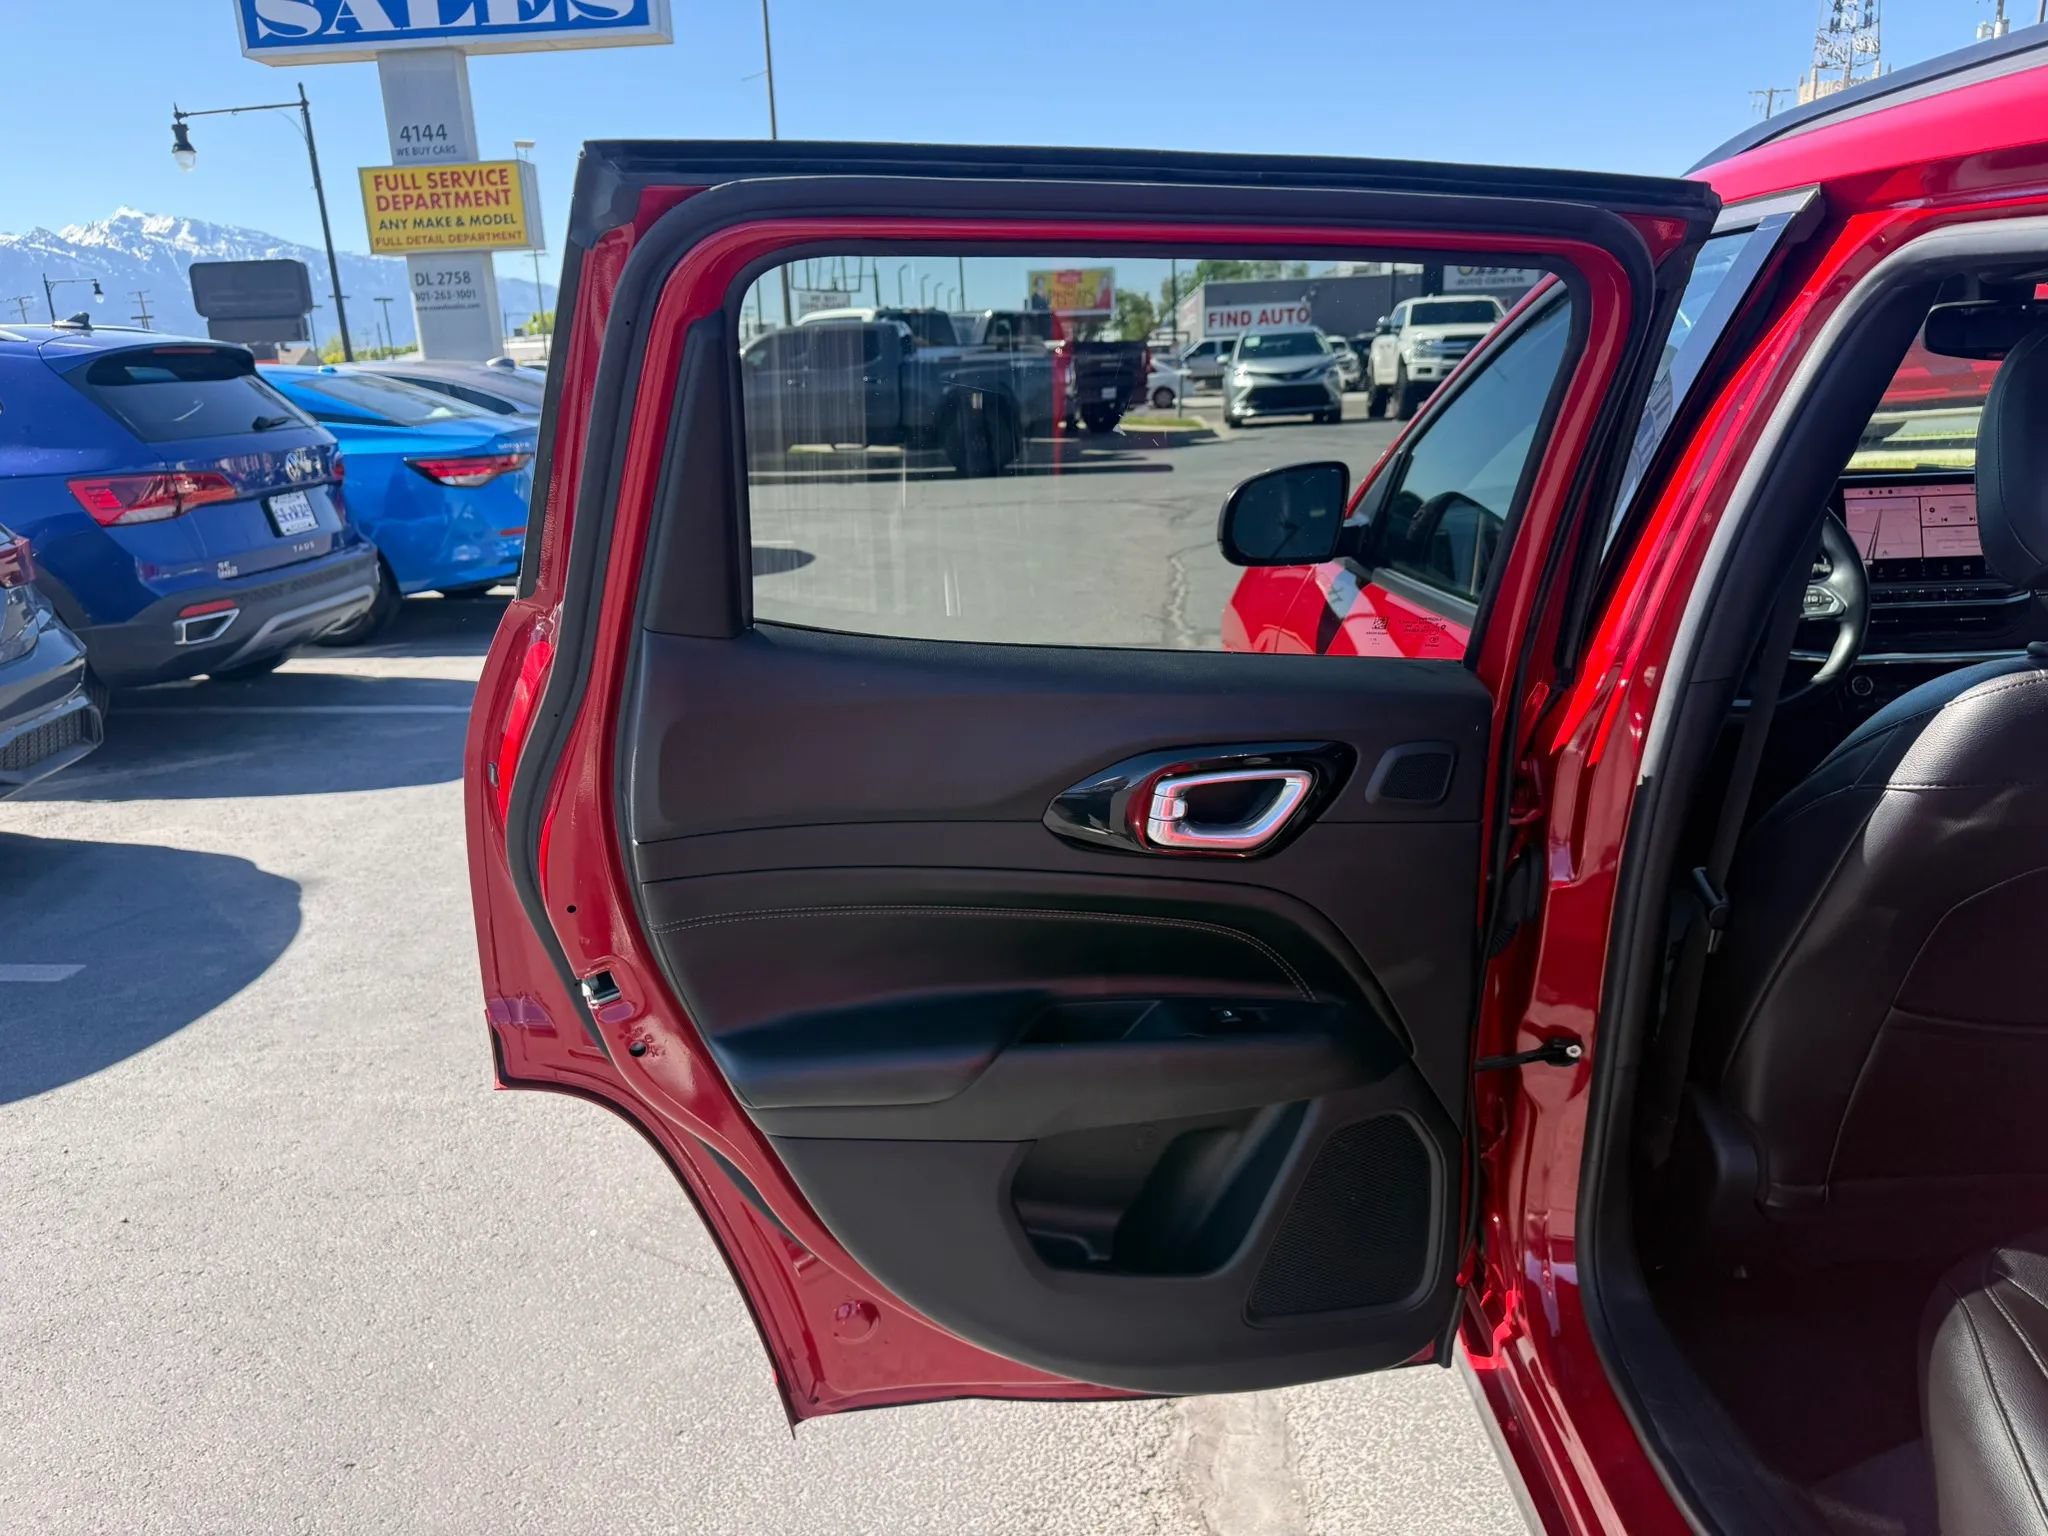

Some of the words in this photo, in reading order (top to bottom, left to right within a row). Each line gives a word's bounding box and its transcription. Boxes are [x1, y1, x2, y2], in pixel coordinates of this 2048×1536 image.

[399, 123, 448, 142] 4144
[397, 146, 410, 156] WE
[412, 145, 431, 156] BUY
[433, 144, 457, 155] CARS
[373, 171, 422, 192] FULL
[426, 168, 509, 189] SERVICE
[376, 188, 512, 212] DEPARTMENT
[378, 218, 409, 231] ANY
[412, 215, 451, 229] MAKE
[455, 215, 466, 227] &
[470, 213, 517, 226] MODEL
[375, 235, 404, 247] FULL
[406, 233, 445, 246] DETAIL
[448, 230, 523, 243] DEPARTMENT
[415, 271, 434, 287] DL
[436, 270, 472, 286] 2758
[1207, 310, 1252, 329] FIND
[1257, 306, 1311, 325] AUTO
